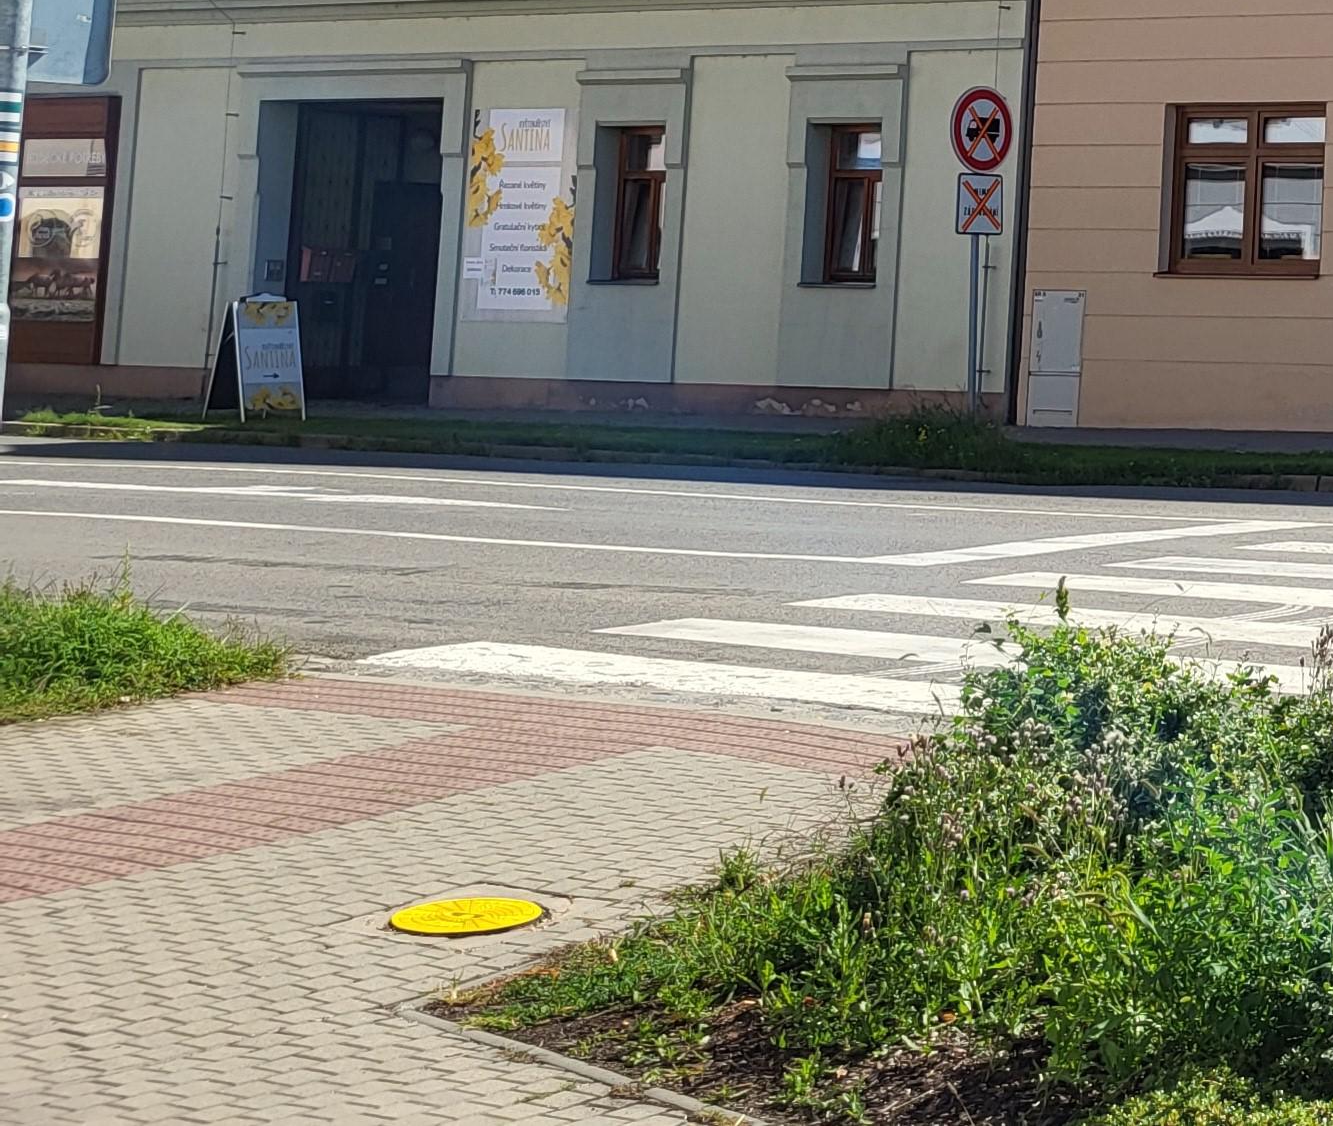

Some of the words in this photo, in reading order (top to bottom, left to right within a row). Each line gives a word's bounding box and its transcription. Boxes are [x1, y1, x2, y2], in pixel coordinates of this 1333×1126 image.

[499, 122, 551, 152] SANTINA
[501, 264, 532, 273] Dekorace
[244, 346, 297, 370] SANTINA
